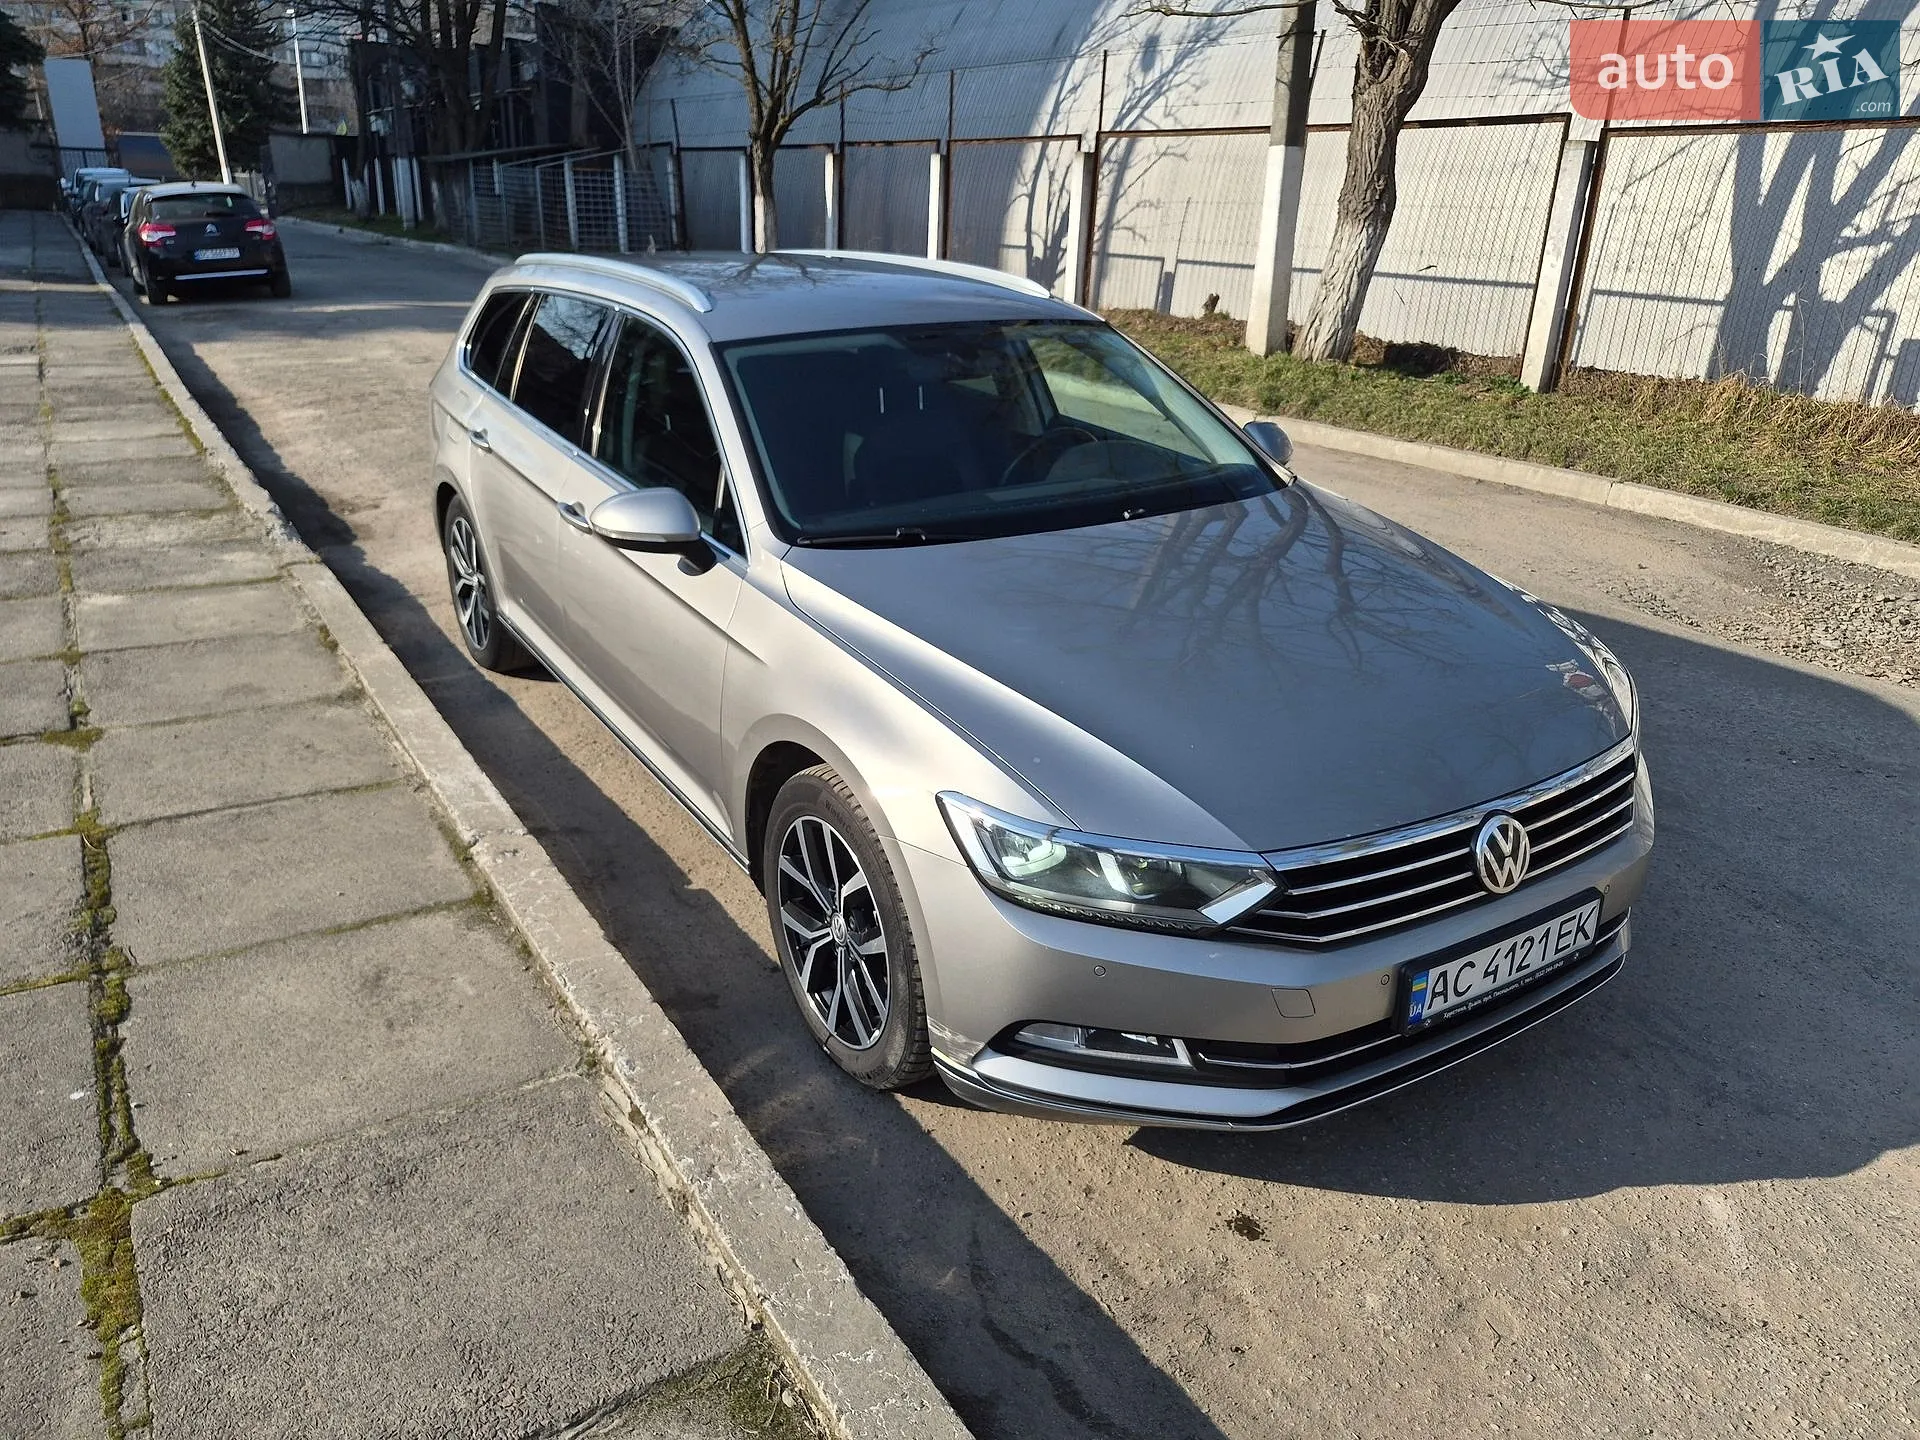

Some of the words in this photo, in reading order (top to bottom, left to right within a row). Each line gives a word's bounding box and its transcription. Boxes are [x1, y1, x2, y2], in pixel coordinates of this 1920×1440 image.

[1427, 961, 1476, 1010] AC
[1482, 927, 1551, 984] 4121
[1554, 906, 1597, 955] EK
[1409, 1004, 1423, 1017] UA
